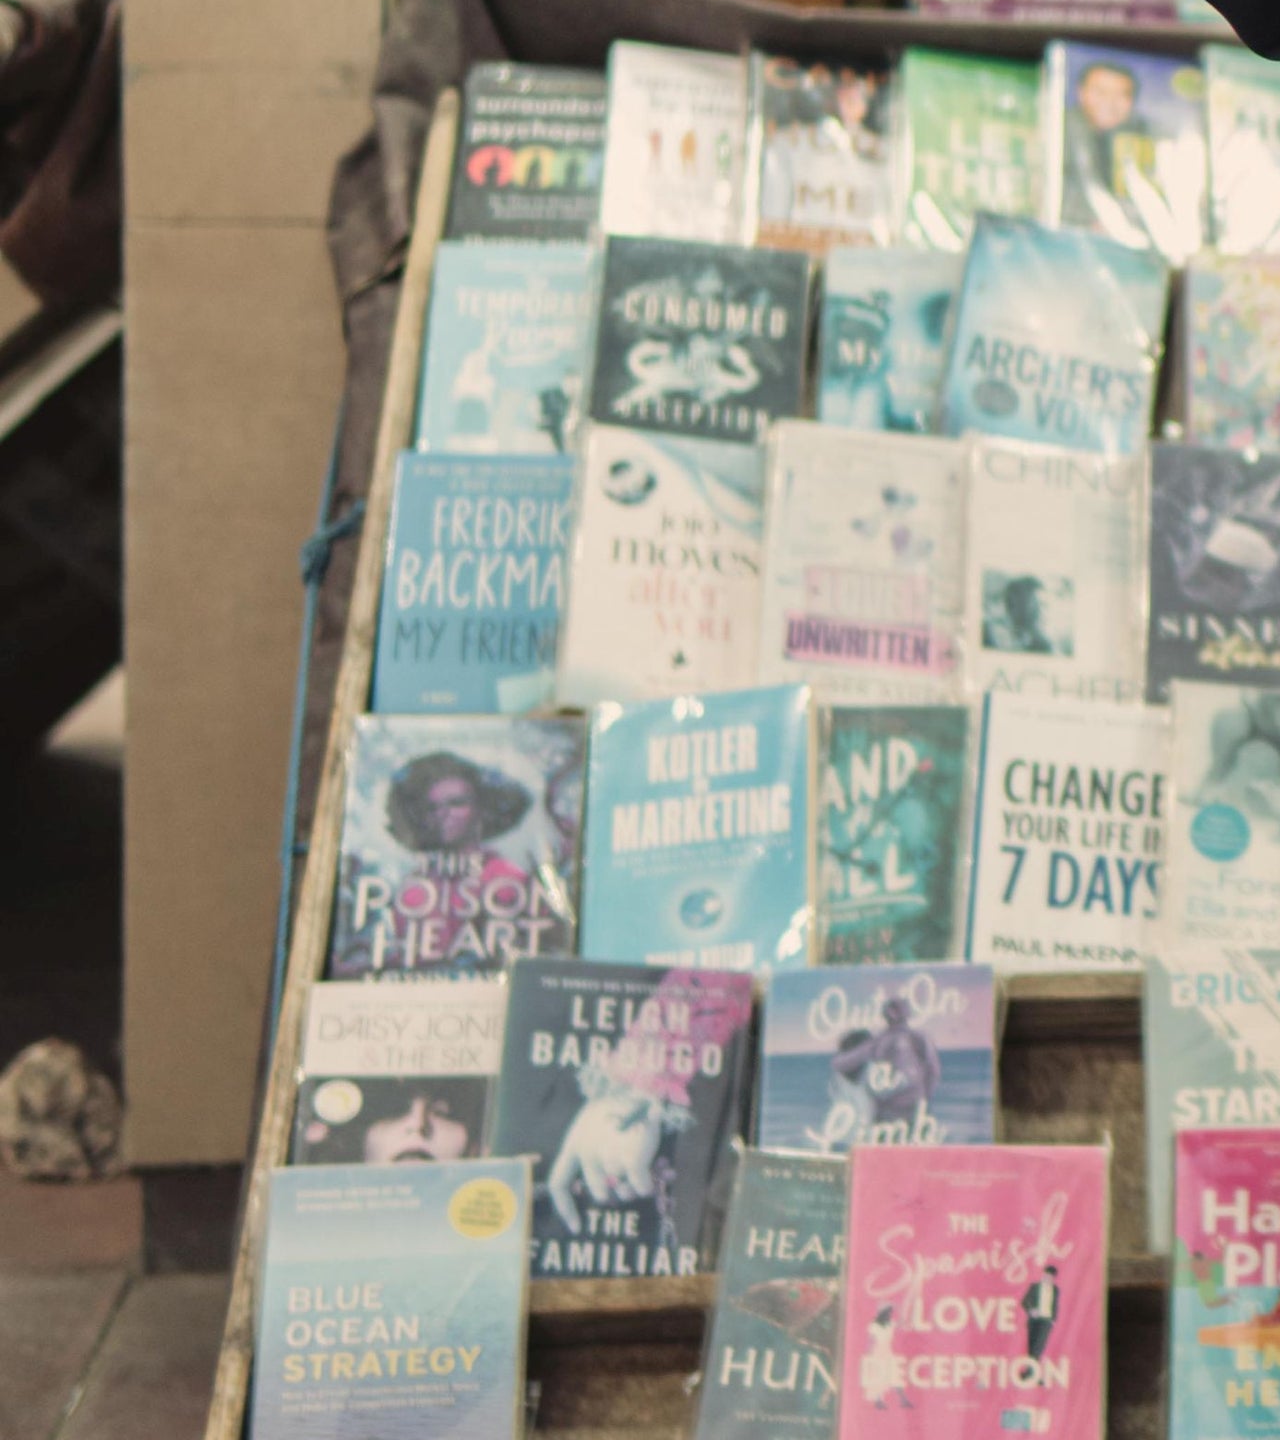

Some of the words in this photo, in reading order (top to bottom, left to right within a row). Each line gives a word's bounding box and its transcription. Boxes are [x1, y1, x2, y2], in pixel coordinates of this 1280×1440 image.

[470, 120, 600, 148] psychopa
[455, 290, 594, 318] TEMPORA
[622, 290, 789, 340] CONSUMED
[965, 333, 1143, 407] ARCHER'S
[982, 452, 1132, 496] CHINU
[395, 549, 565, 611] BACKMA
[392, 612, 447, 665] MY
[459, 614, 556, 666] FRIEN
[785, 620, 931, 668] UNWRITTEN
[646, 723, 759, 786] KOTLER
[1003, 758, 1165, 818] CHANGE
[611, 783, 792, 855] MARKETING
[1002, 812, 1073, 847] YOUR
[1080, 815, 1133, 852] LIFE
[418, 851, 485, 878] THIS
[1000, 846, 1028, 905] 7
[352, 873, 560, 930] POISON
[372, 917, 556, 969] HEART
[991, 935, 1047, 960] PAUL
[1052, 940, 1140, 966] McKENN
[317, 1012, 402, 1043] DAISY
[411, 1013, 501, 1043] JONE
[570, 994, 691, 1035] LEIGH
[436, 1044, 483, 1071] SIX
[531, 1030, 724, 1077] BARDUGO
[586, 1208, 640, 1238] THE
[948, 1211, 990, 1236] THE
[529, 1236, 700, 1278] FAMILIAR
[865, 1190, 1074, 1308] Spanish
[286, 1280, 385, 1315] BLUE
[912, 1295, 1018, 1333] LOVE
[283, 1313, 422, 1350] OCEAN
[280, 1344, 483, 1385] STRATEGY
[718, 1343, 839, 1395] HUN
[859, 1354, 1071, 1391] DECEPTION
